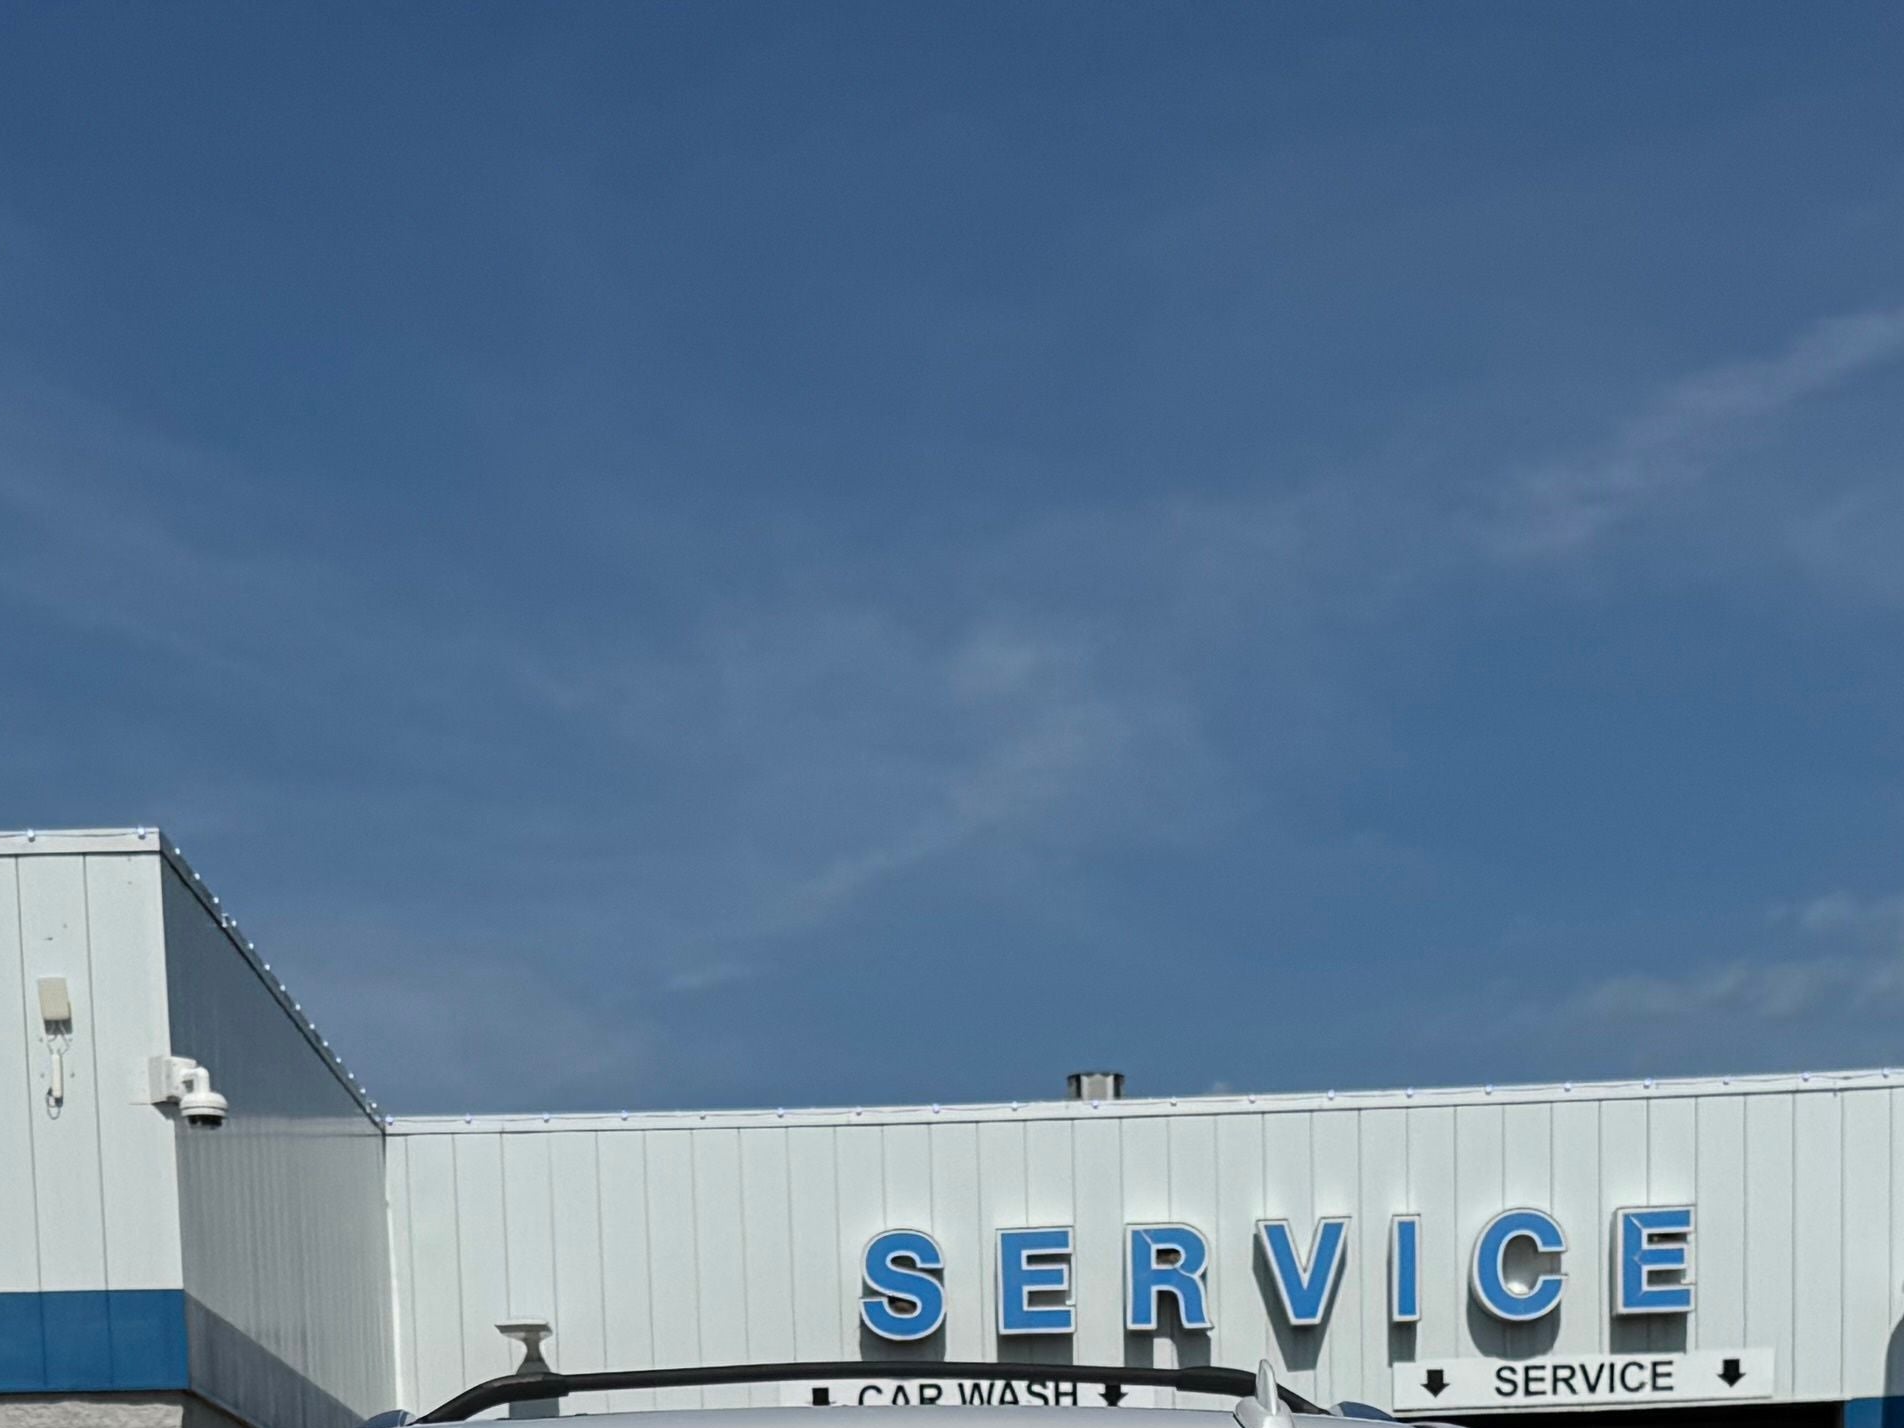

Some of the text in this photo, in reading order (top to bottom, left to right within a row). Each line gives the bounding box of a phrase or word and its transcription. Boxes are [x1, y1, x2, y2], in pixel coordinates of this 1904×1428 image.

[859, 1204, 1696, 1341] SERVICE
[858, 1380, 1078, 1406] CAR WASH
[1494, 1360, 1674, 1397] SERVICE
